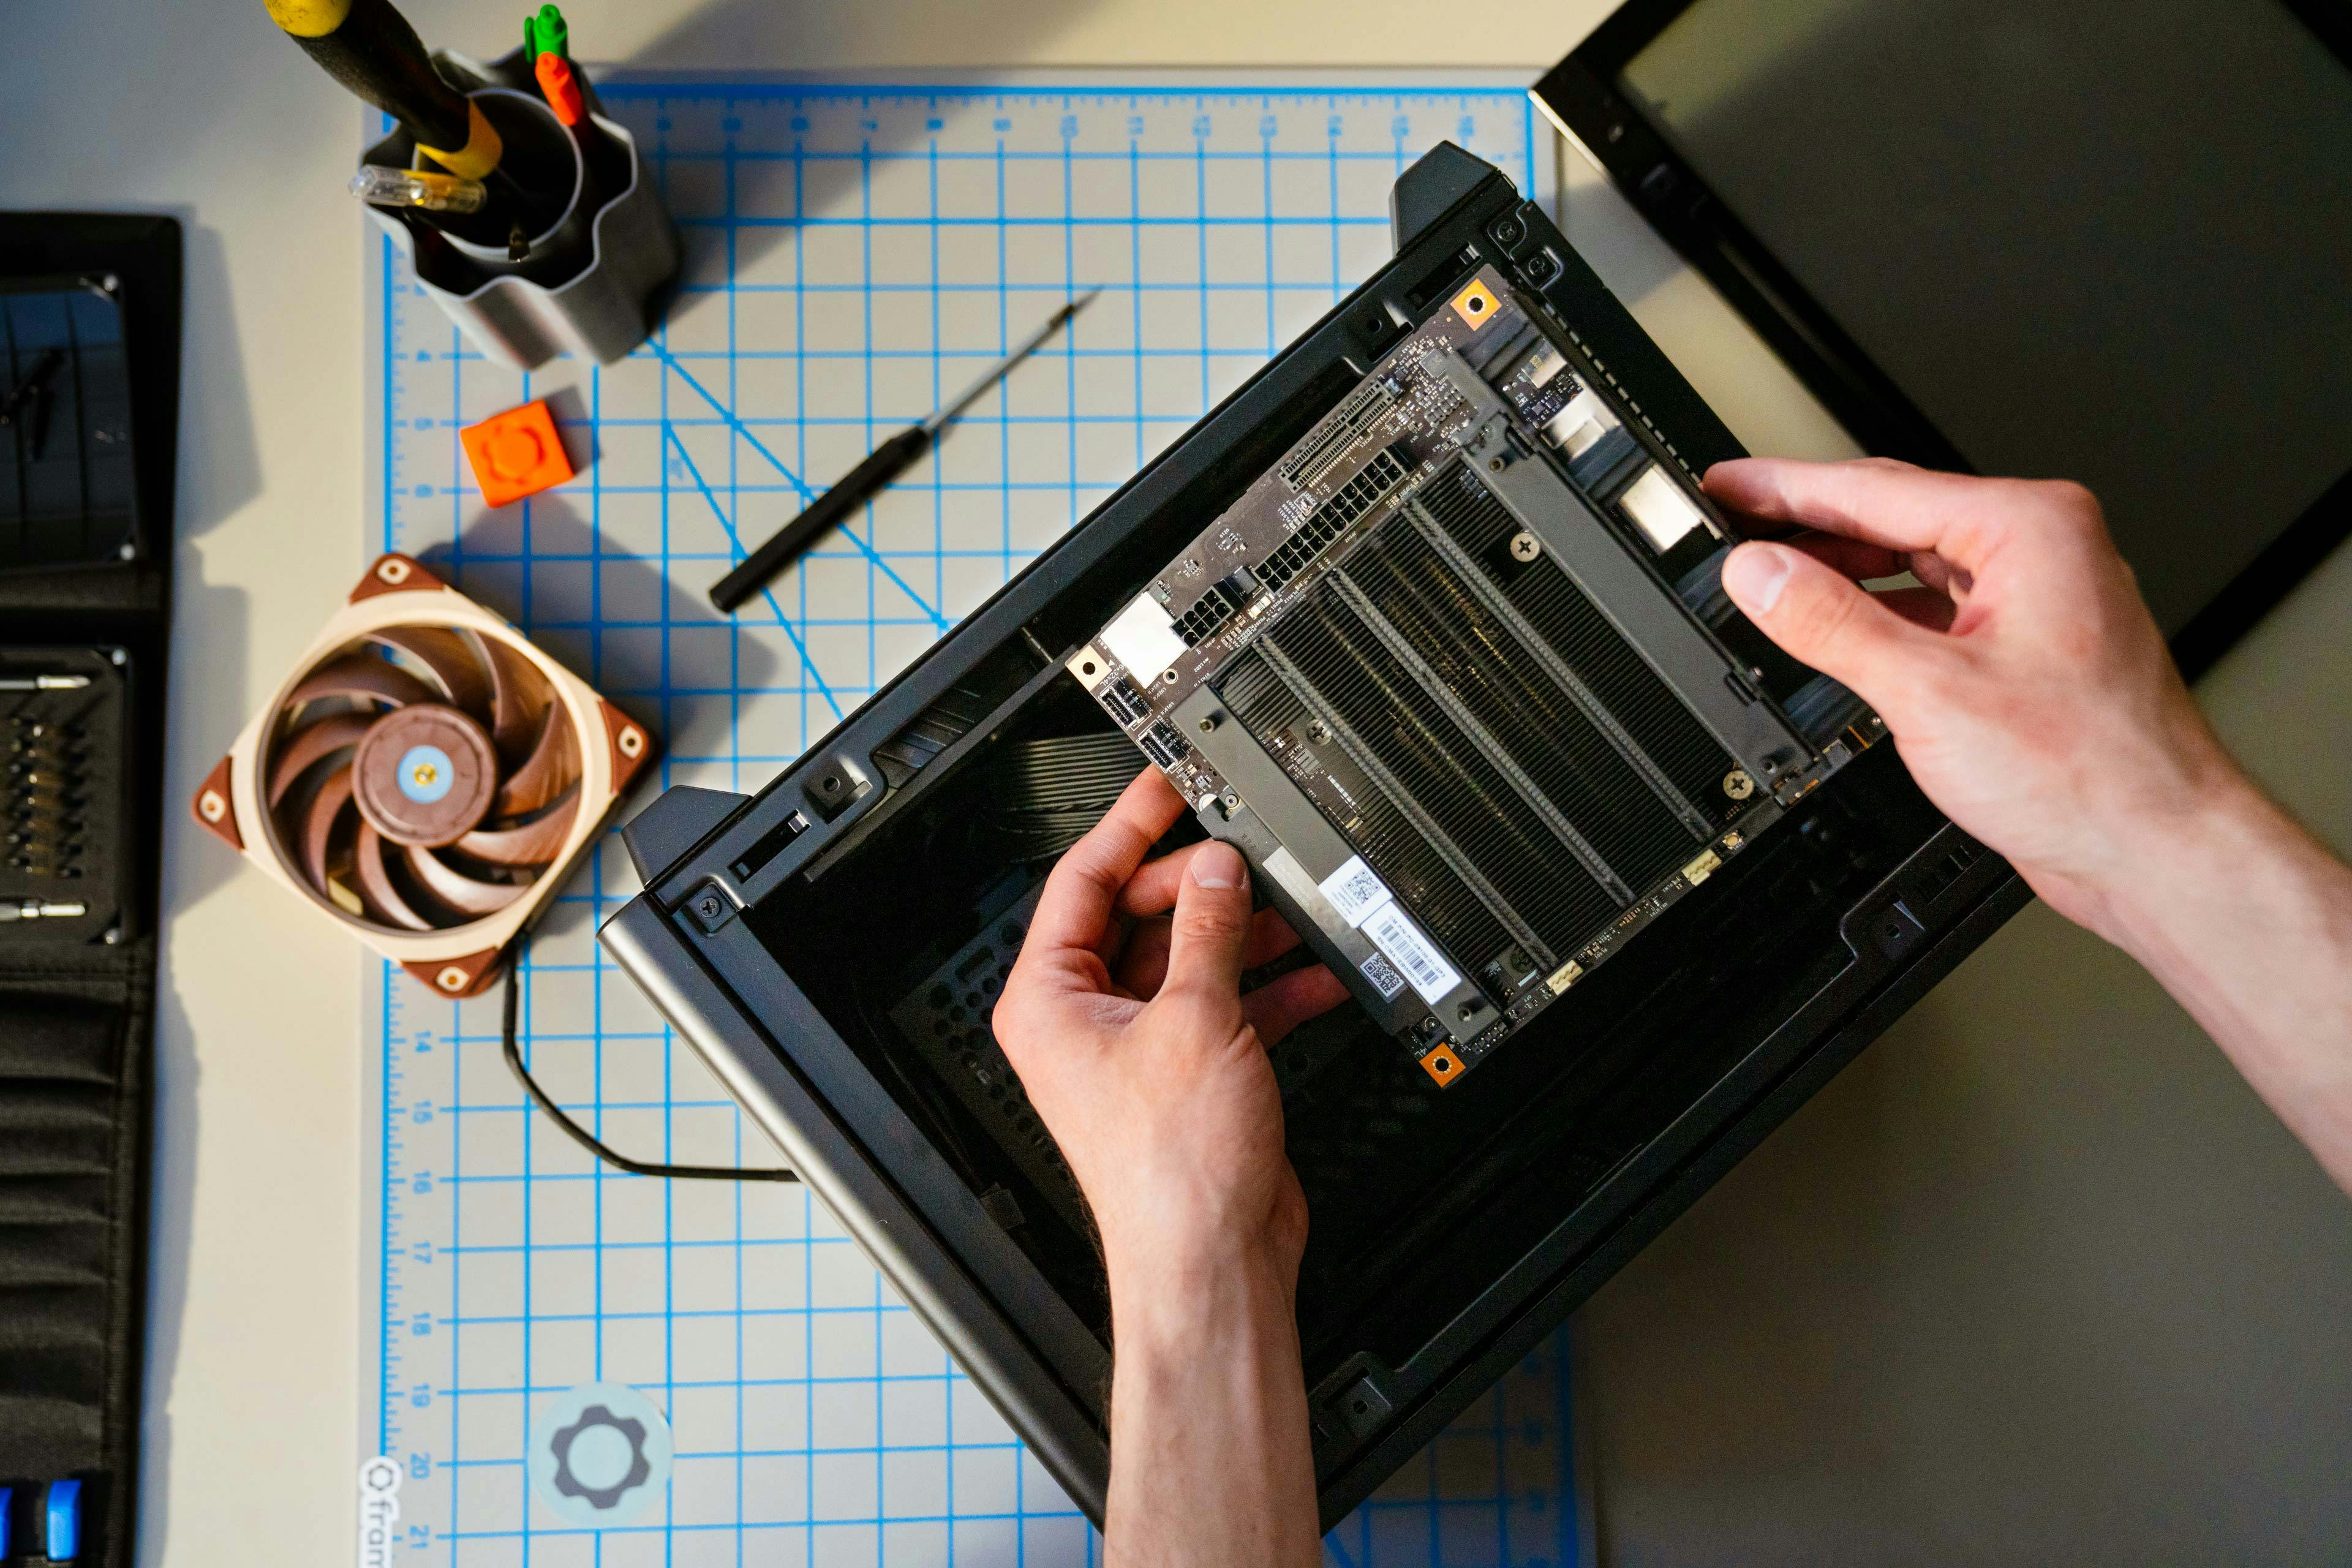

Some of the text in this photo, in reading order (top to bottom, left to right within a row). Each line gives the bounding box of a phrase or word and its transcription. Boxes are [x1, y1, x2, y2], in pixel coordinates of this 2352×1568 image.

[415, 1030, 432, 1053] 14
[413, 1101, 432, 1124] 15
[413, 1241, 432, 1264] 17
[411, 1383, 431, 1408] 19
[410, 1452, 431, 1479] 20
[409, 1525, 429, 1548] 21
